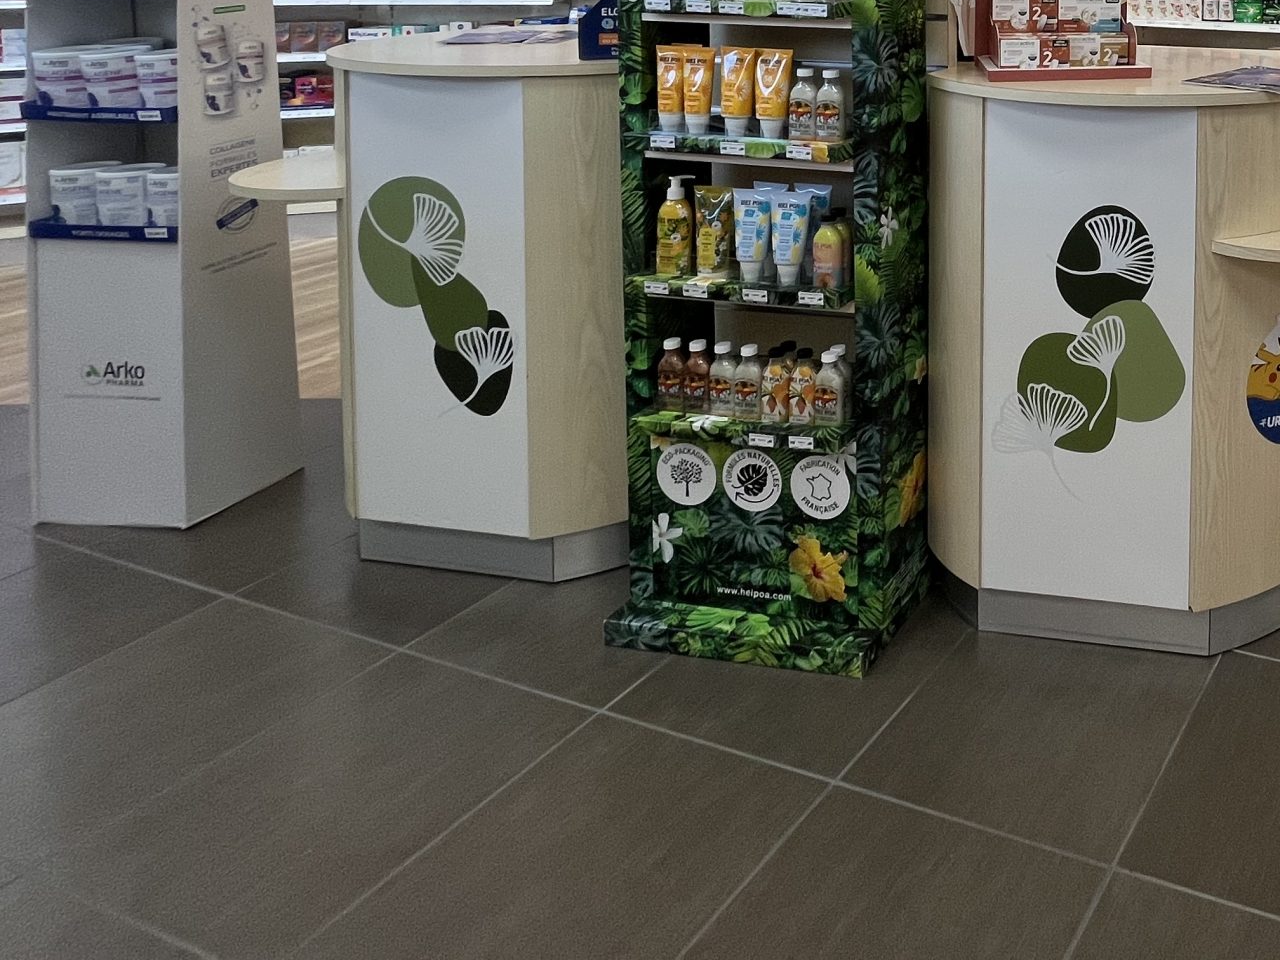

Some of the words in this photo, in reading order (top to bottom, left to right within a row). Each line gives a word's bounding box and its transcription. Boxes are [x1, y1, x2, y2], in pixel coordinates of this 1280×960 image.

[1032, 6, 1041, 21] 2
[1042, 50, 1052, 66] 2
[1103, 47, 1113, 62] 2
[103, 360, 146, 380] Arko
[105, 378, 145, 387] PHARMA
[725, 451, 746, 484] FORMULES
[747, 451, 780, 489] NATURELLES
[799, 459, 841, 477] FABRICATION
[800, 495, 841, 515] FRANÇAISE
[716, 585, 792, 602] www.heipoa.com
